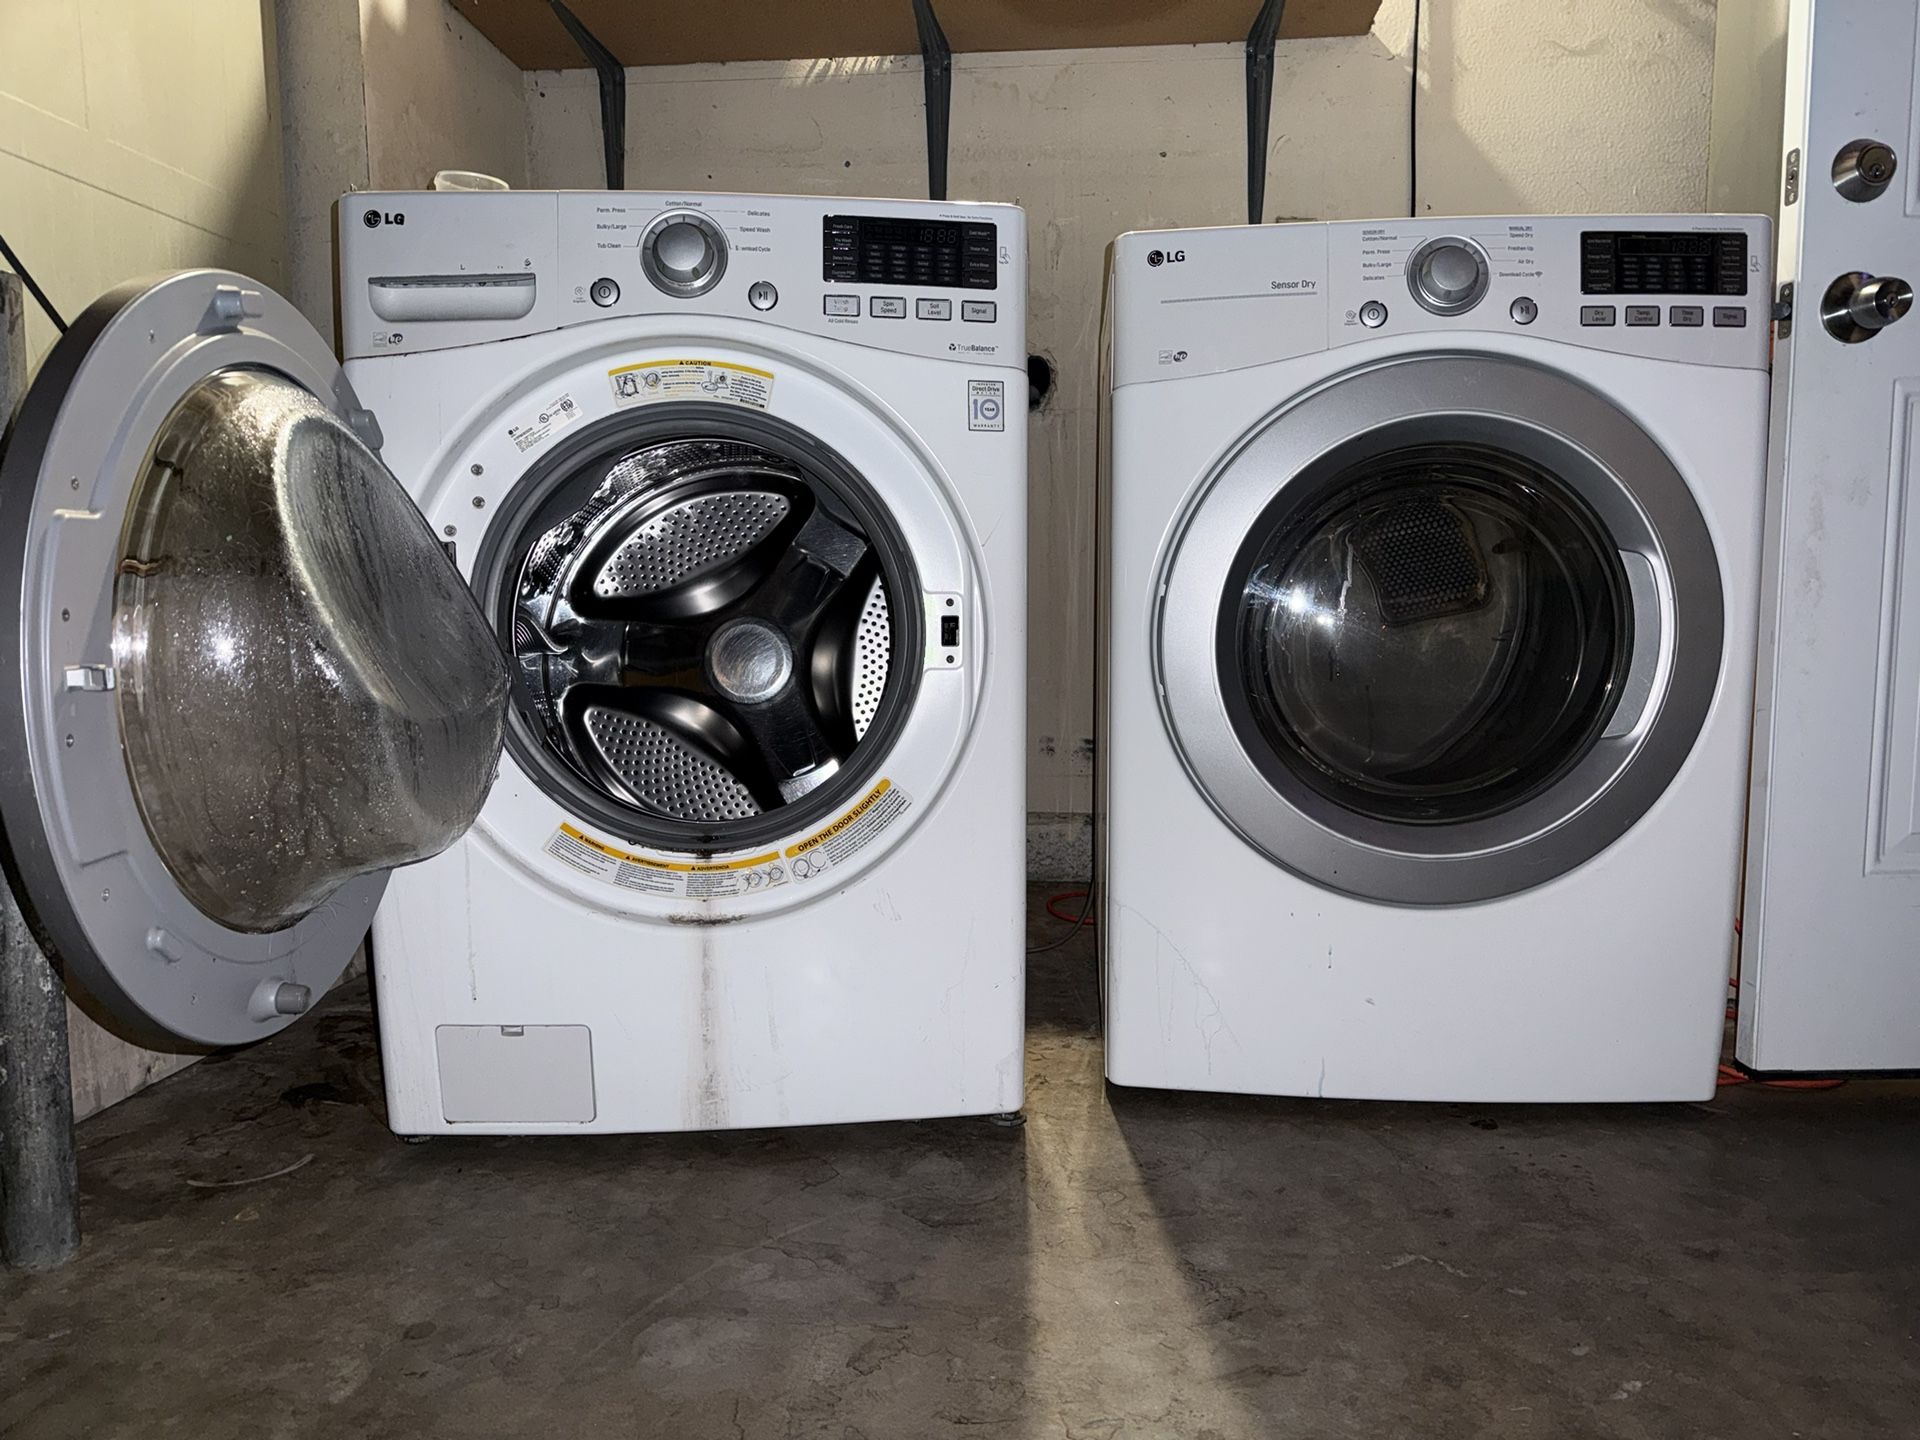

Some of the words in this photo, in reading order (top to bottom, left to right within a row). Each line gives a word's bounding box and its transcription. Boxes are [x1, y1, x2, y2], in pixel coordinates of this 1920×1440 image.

[384, 213, 405, 226] LG
[1166, 250, 1186, 263] LG
[1271, 280, 1300, 289] Sensor
[1301, 280, 1316, 289] Dry
[971, 307, 987, 315] Signal
[973, 398, 1000, 420] 10
[798, 838, 819, 852] OPEN
[818, 829, 833, 841] THE
[832, 814, 854, 832] DOOR
[852, 789, 882, 818] SLIGHTLY
[584, 837, 605, 851] WARNING
